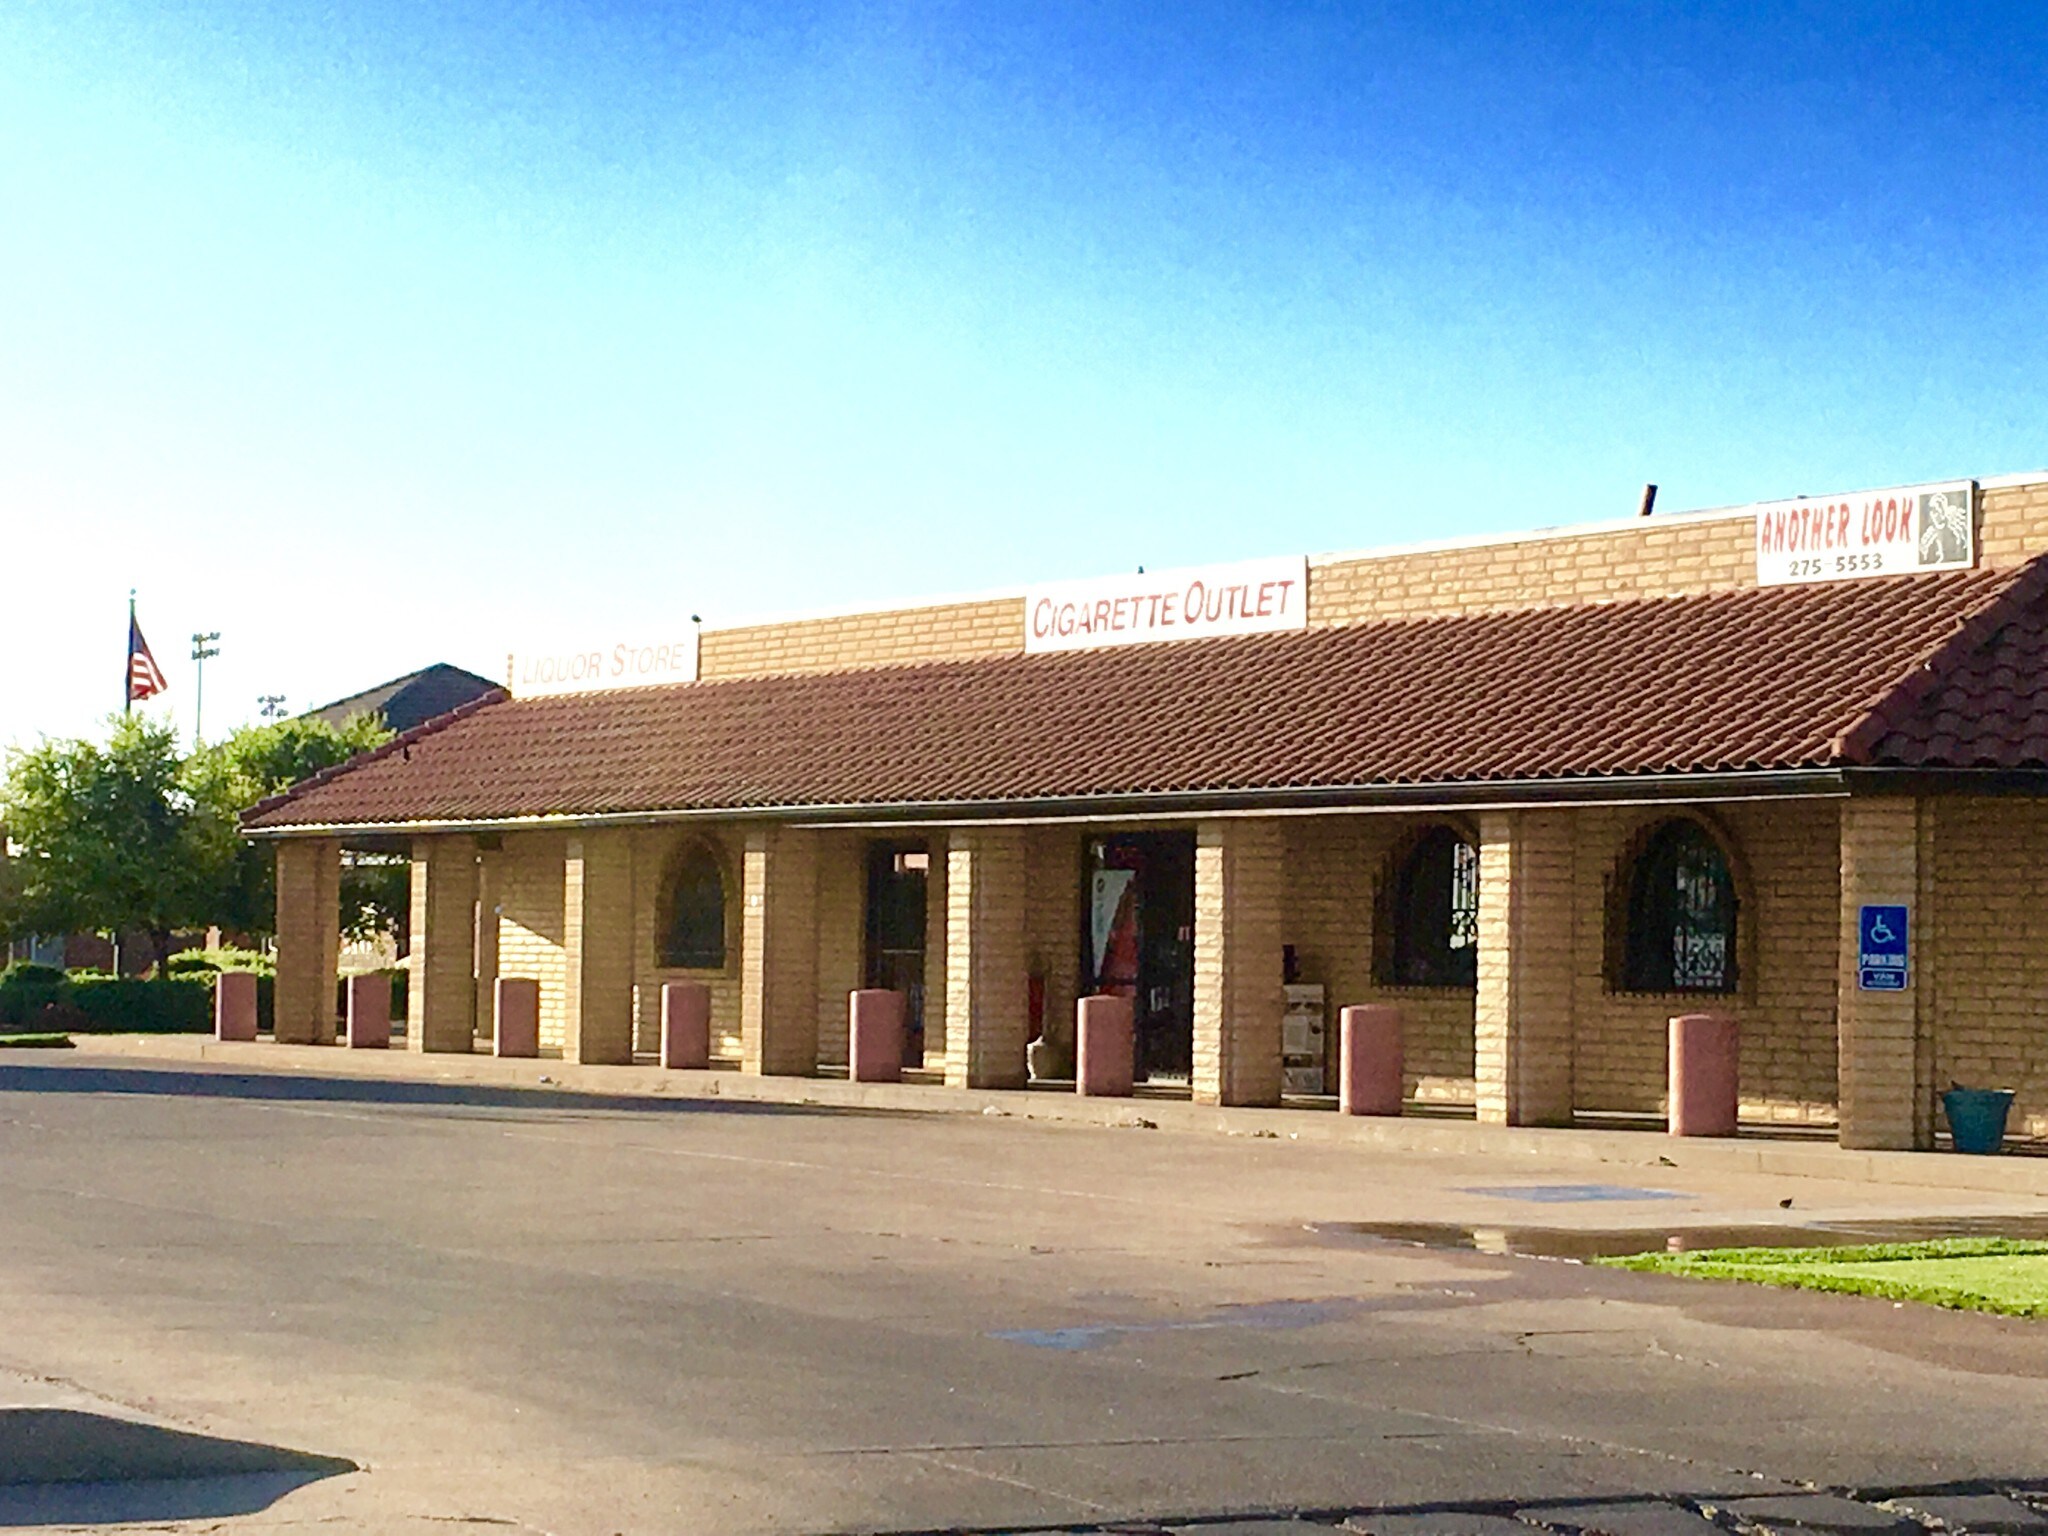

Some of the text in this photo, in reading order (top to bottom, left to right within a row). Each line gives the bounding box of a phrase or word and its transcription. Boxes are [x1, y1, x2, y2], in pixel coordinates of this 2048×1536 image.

[1761, 497, 1913, 554] ANOTHER LOOK
[1033, 580, 1295, 638] CIGARETTE OUTLET
[522, 643, 685, 684] LIQUOR STORE
